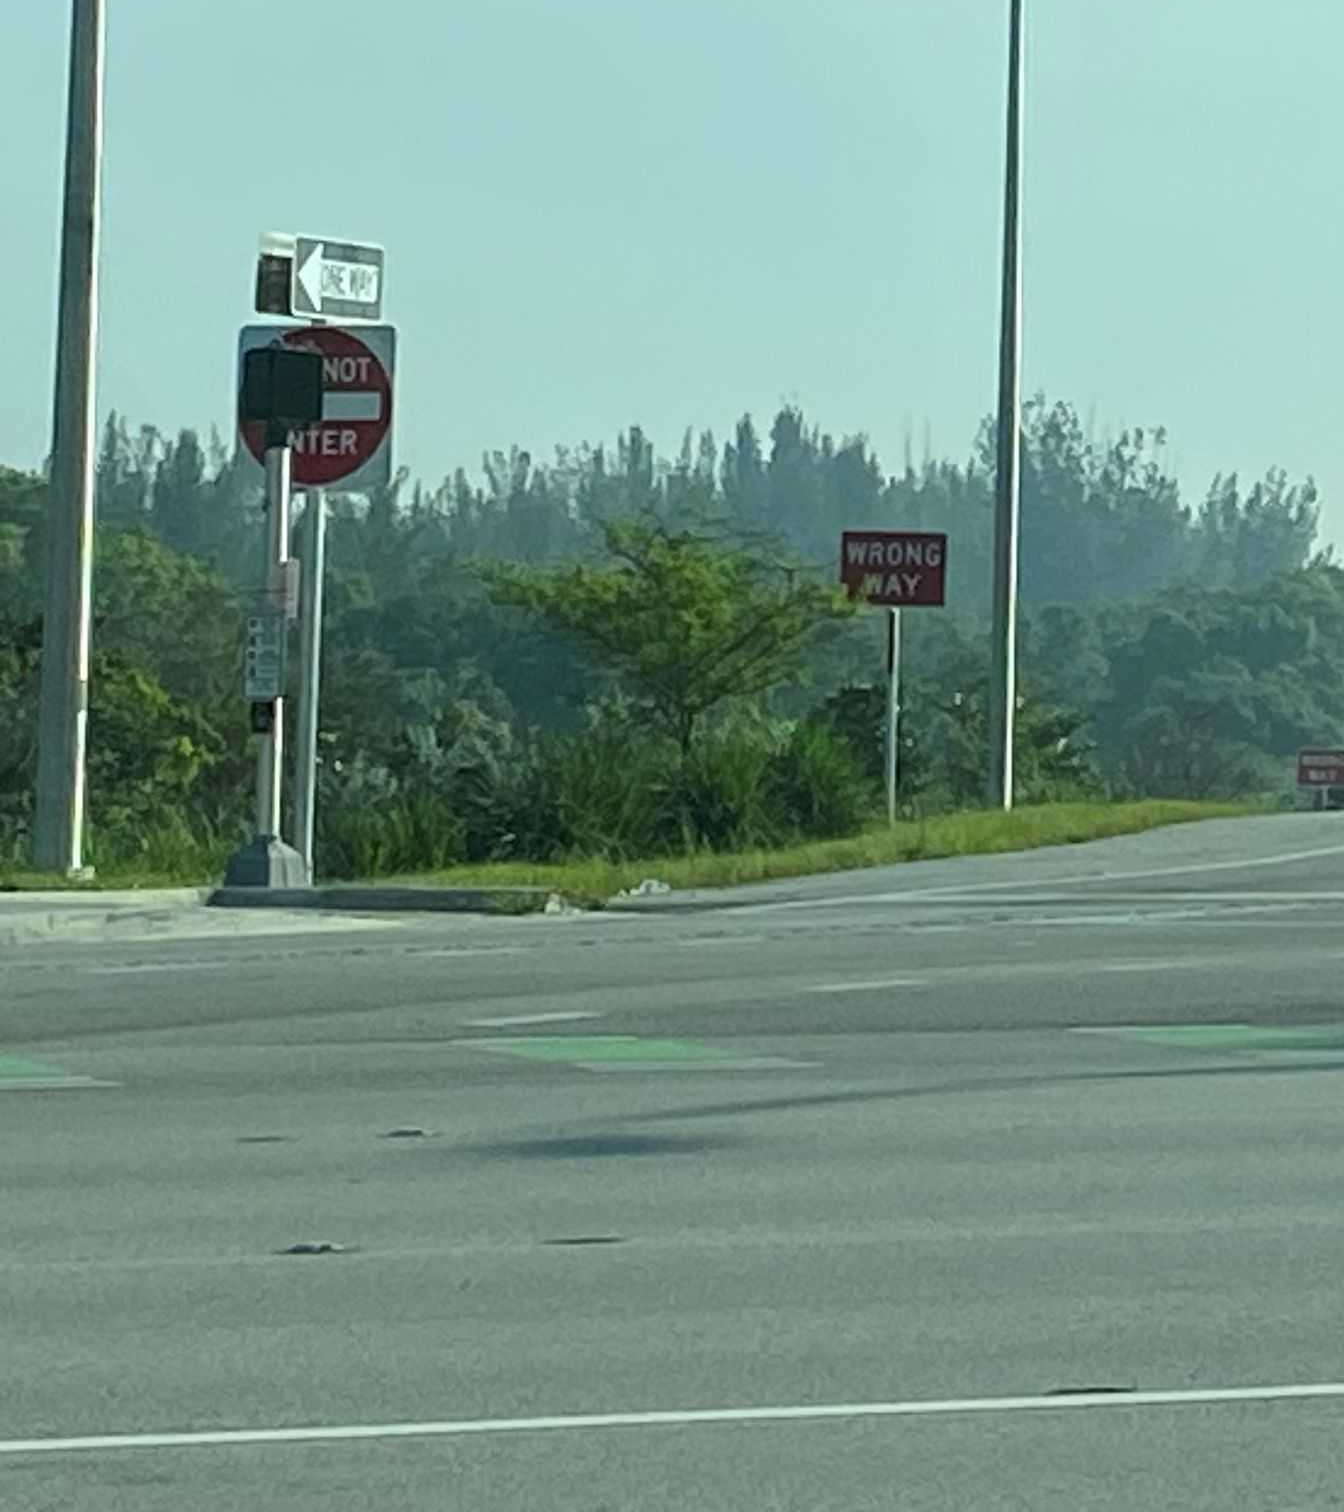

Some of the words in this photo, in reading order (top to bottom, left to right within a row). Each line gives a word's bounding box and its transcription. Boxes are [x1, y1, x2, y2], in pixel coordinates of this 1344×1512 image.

[321, 356, 371, 383] NOT
[286, 429, 358, 456] NTER
[846, 541, 941, 567] WRONG
[862, 573, 921, 597] WAY
